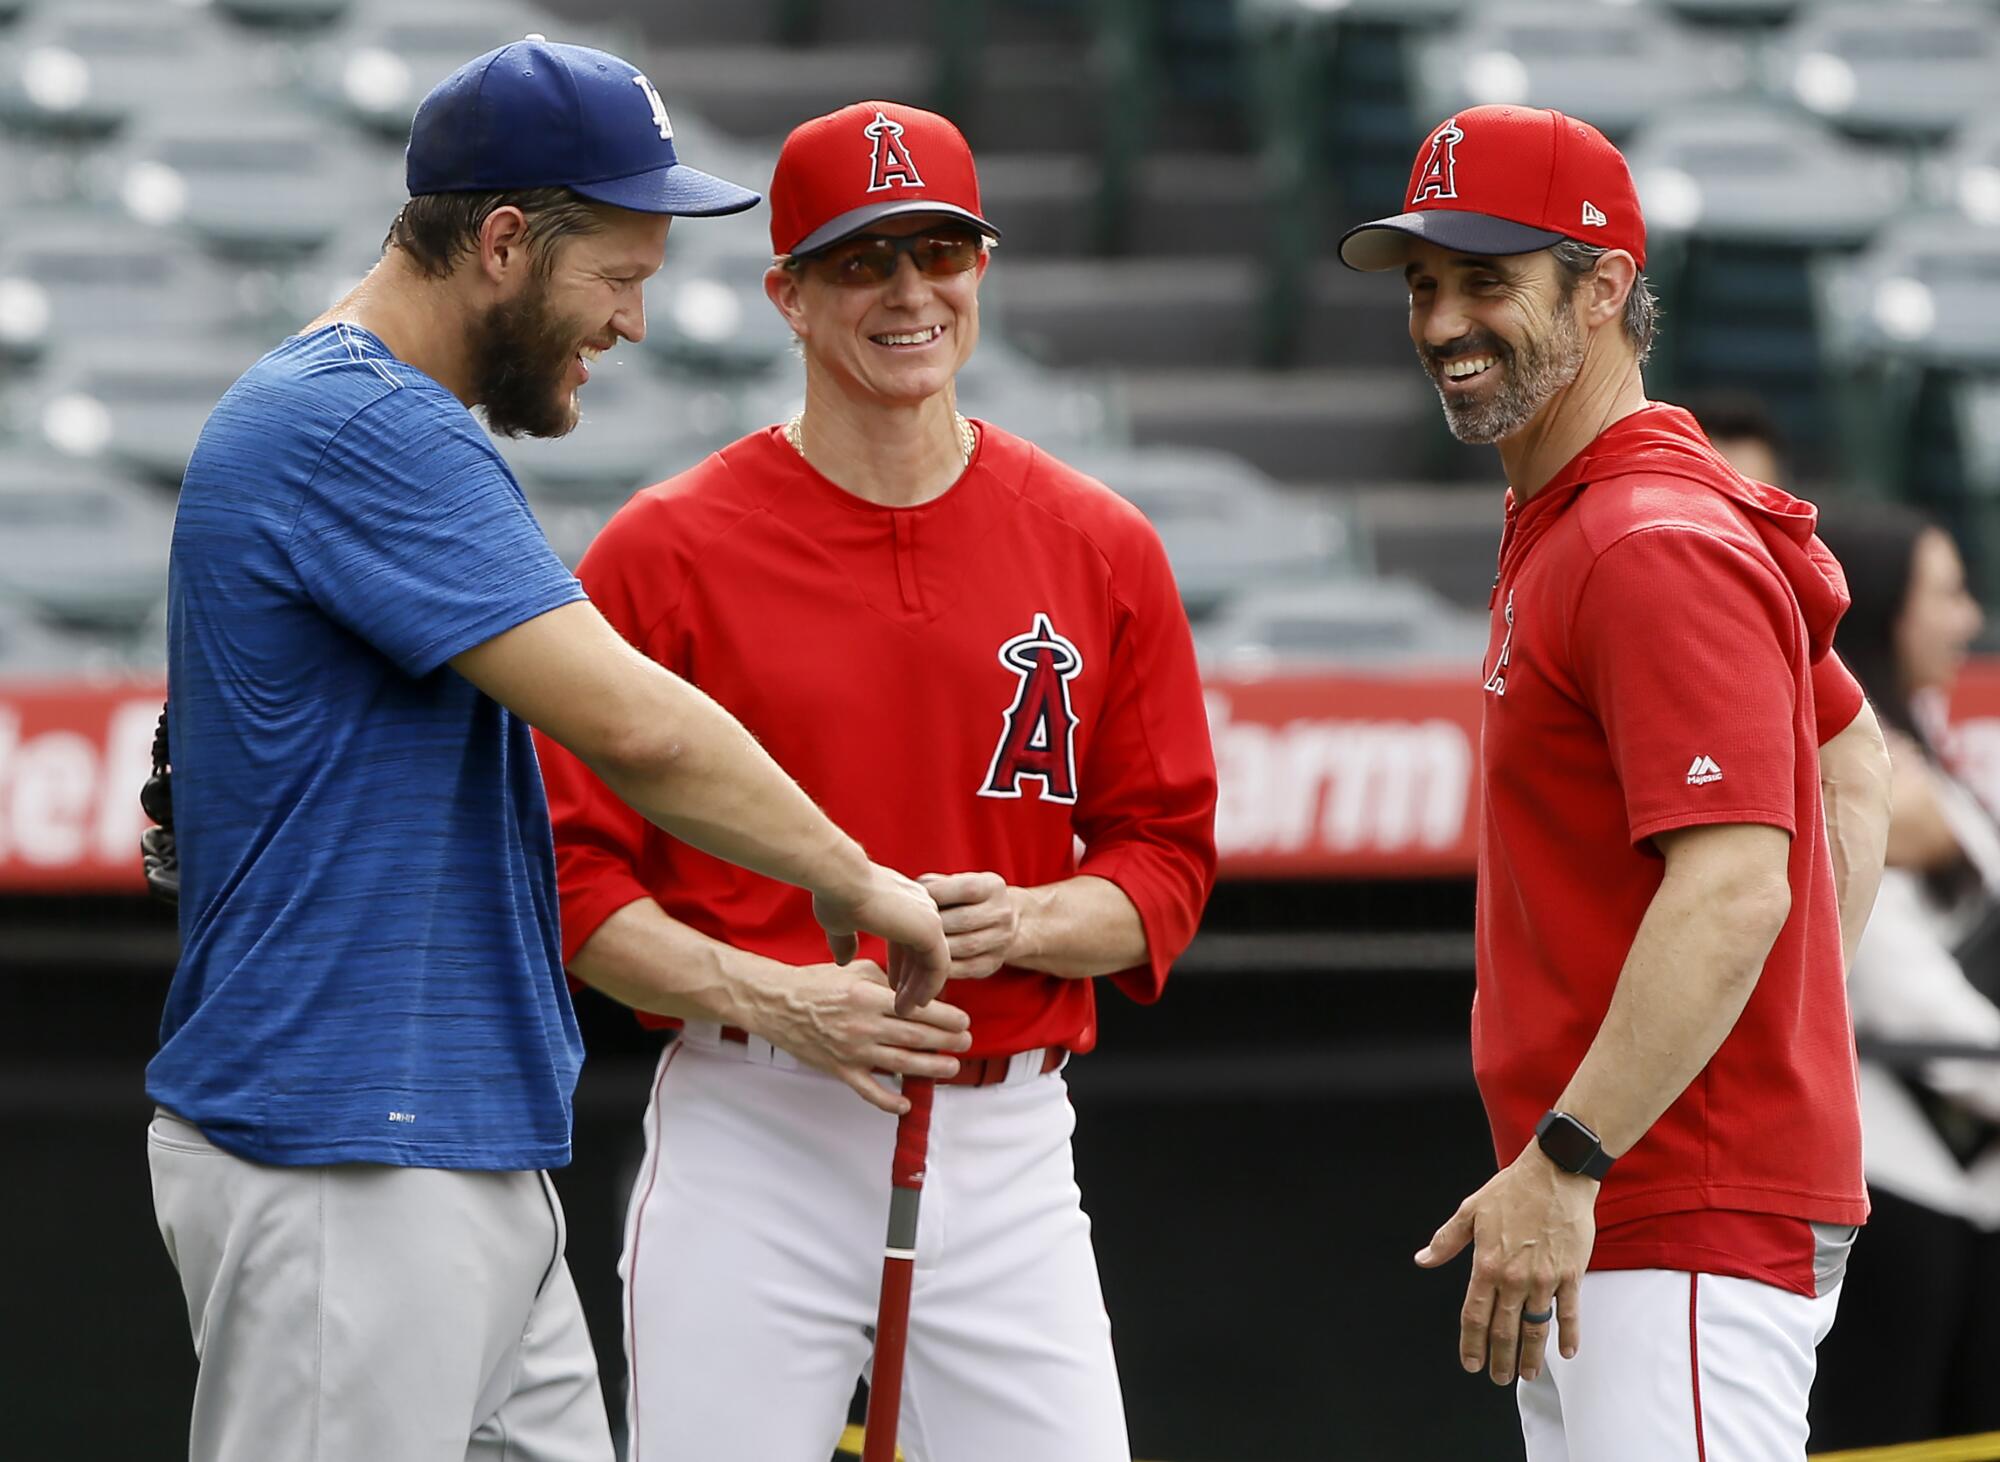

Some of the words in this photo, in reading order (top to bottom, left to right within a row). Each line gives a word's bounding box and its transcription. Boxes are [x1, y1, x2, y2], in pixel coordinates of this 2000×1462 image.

[864, 112, 926, 193] A
[1411, 118, 1464, 205] A
[976, 612, 1083, 805] A
[1203, 690, 1475, 857] arm
